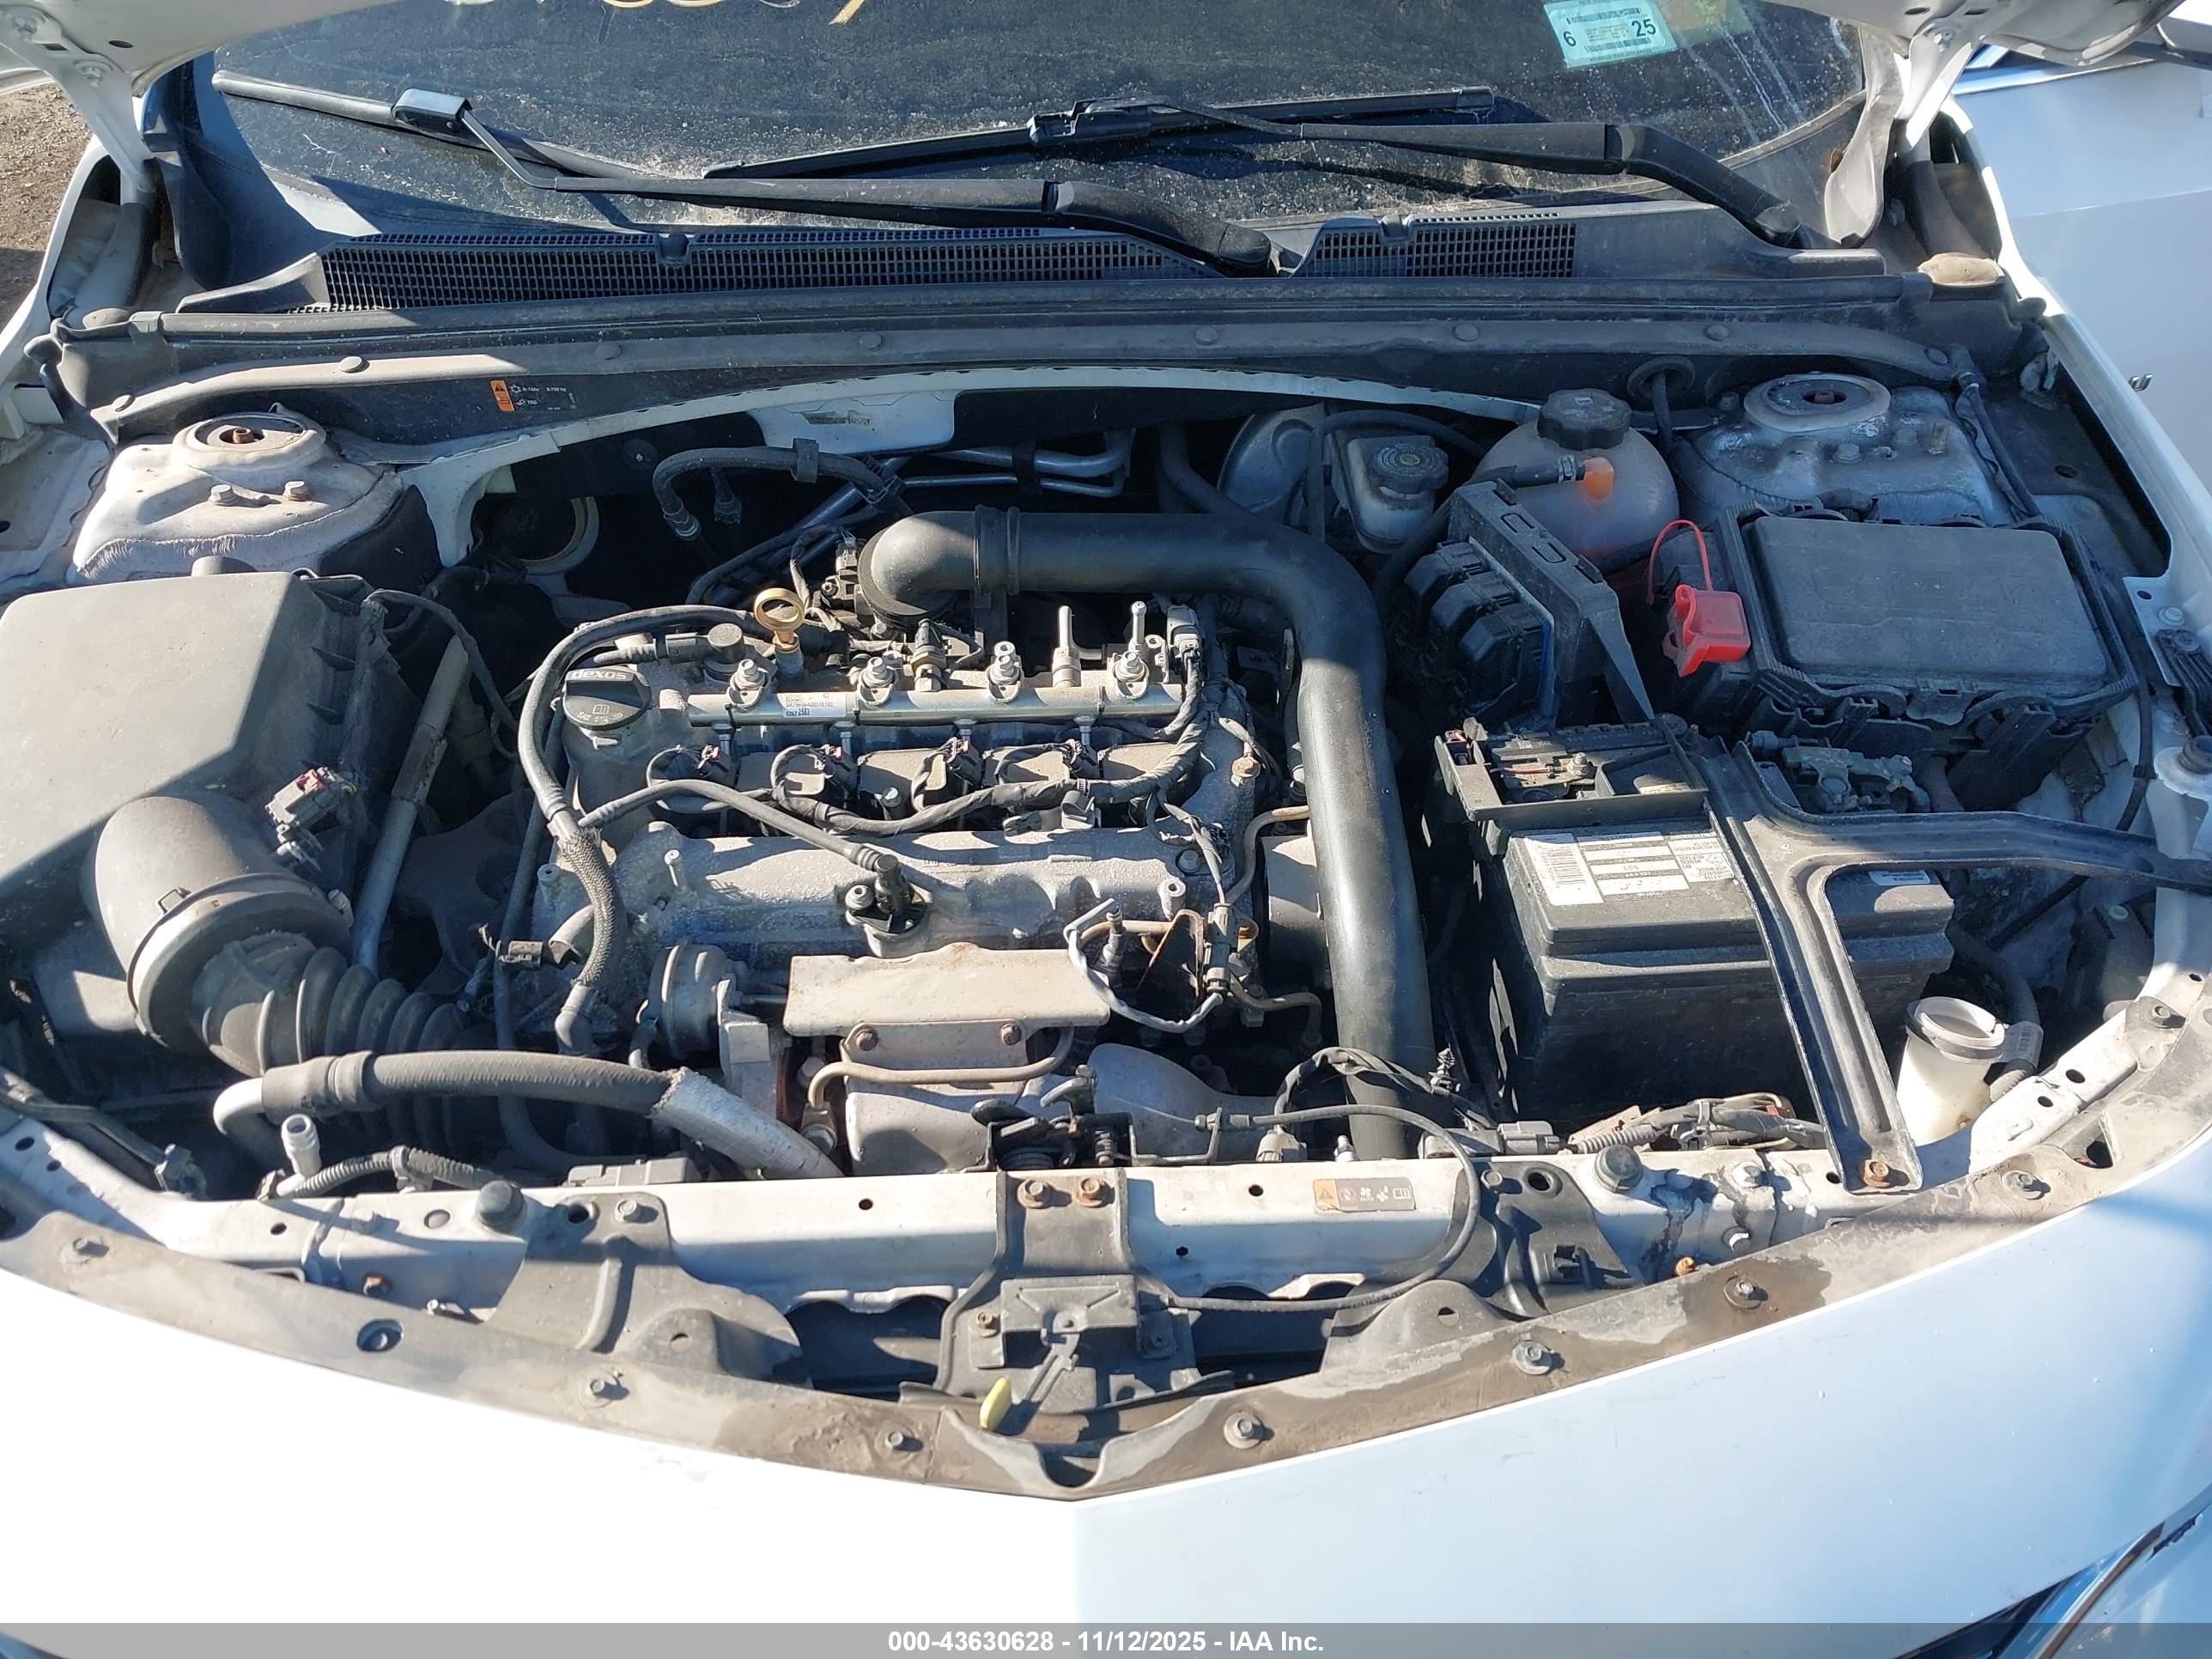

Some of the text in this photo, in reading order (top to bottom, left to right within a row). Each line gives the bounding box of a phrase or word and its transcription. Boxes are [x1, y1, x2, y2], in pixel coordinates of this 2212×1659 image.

[1563, 31, 1577, 47] 6
[1632, 18, 1656, 37] 25
[571, 671, 627, 680] dexos
